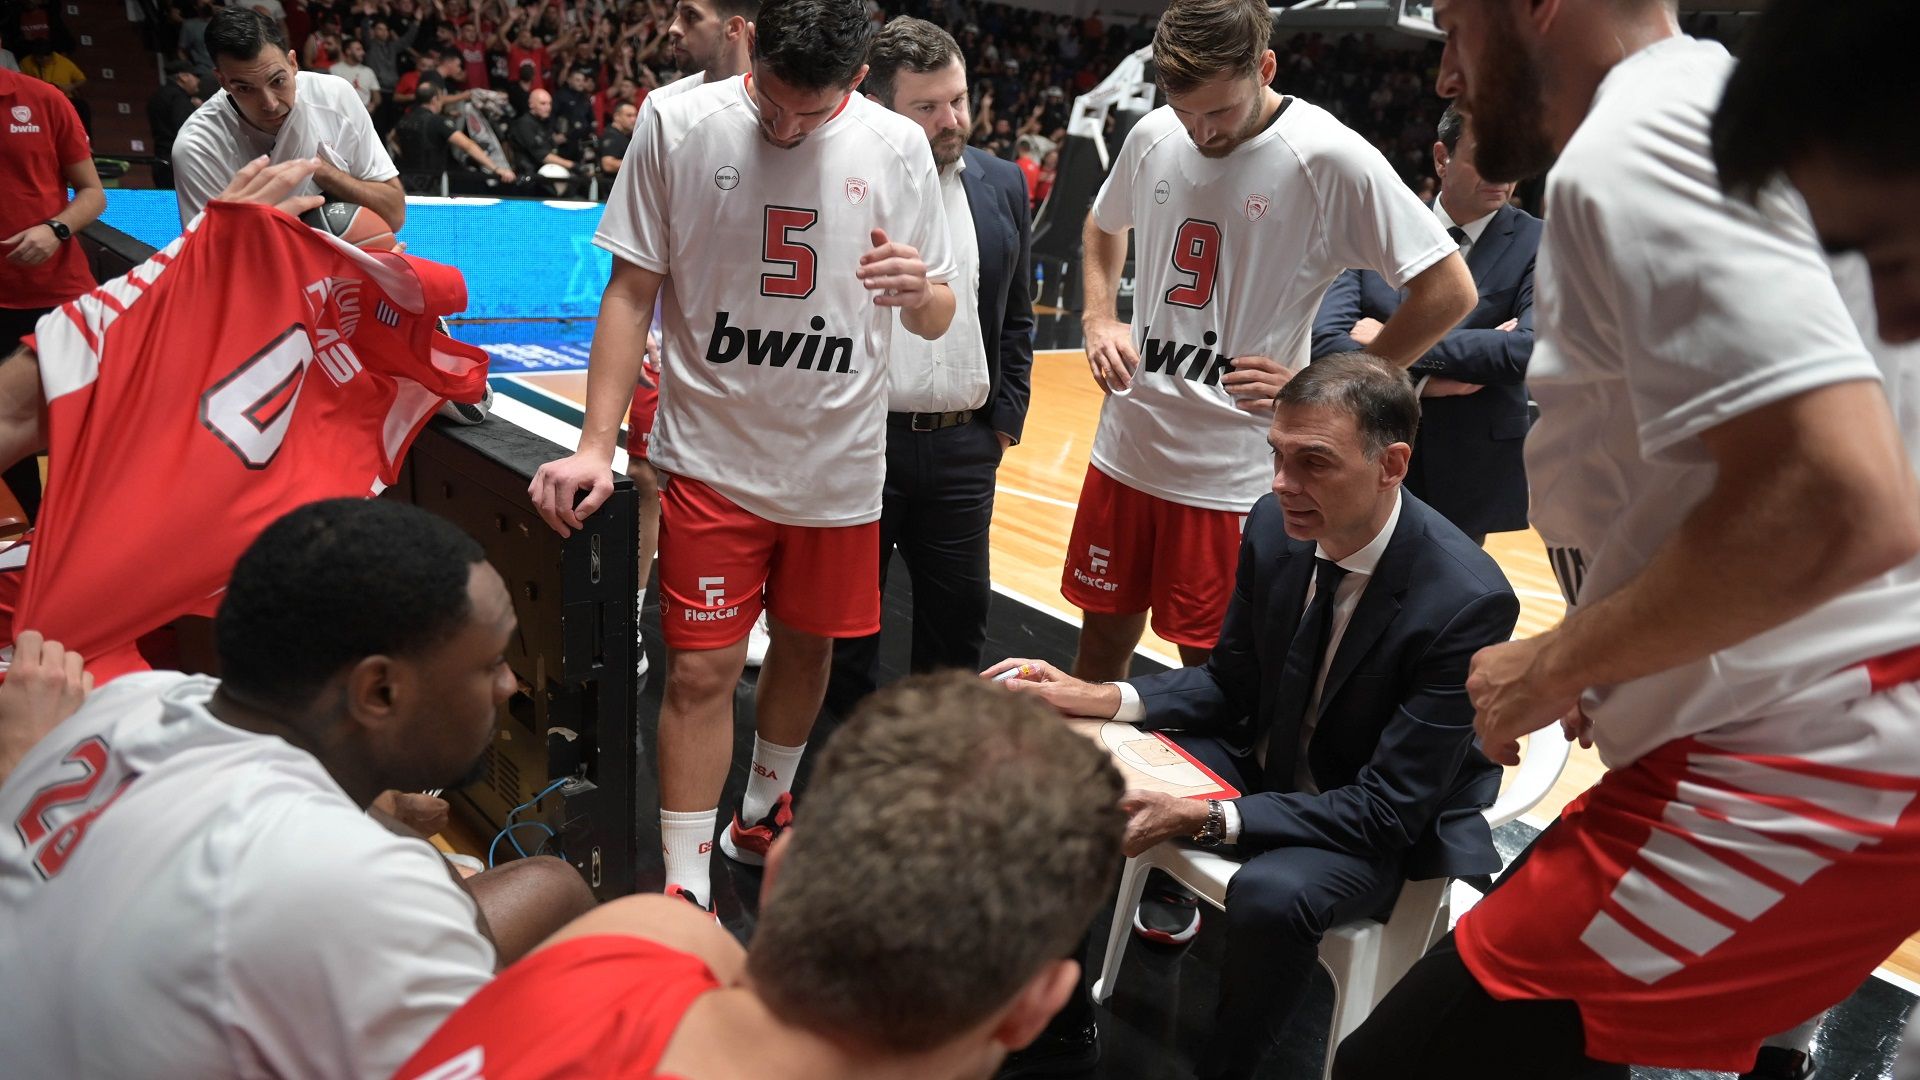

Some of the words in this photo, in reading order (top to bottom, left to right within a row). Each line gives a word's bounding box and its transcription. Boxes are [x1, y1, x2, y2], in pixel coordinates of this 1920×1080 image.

[10, 123, 40, 133] bwin
[760, 205, 818, 299] 5
[1165, 218, 1222, 309] 9
[706, 311, 854, 374] bwin
[1140, 325, 1236, 388] win
[1074, 568, 1118, 592] FlexCar
[684, 606, 739, 621] FlexCar
